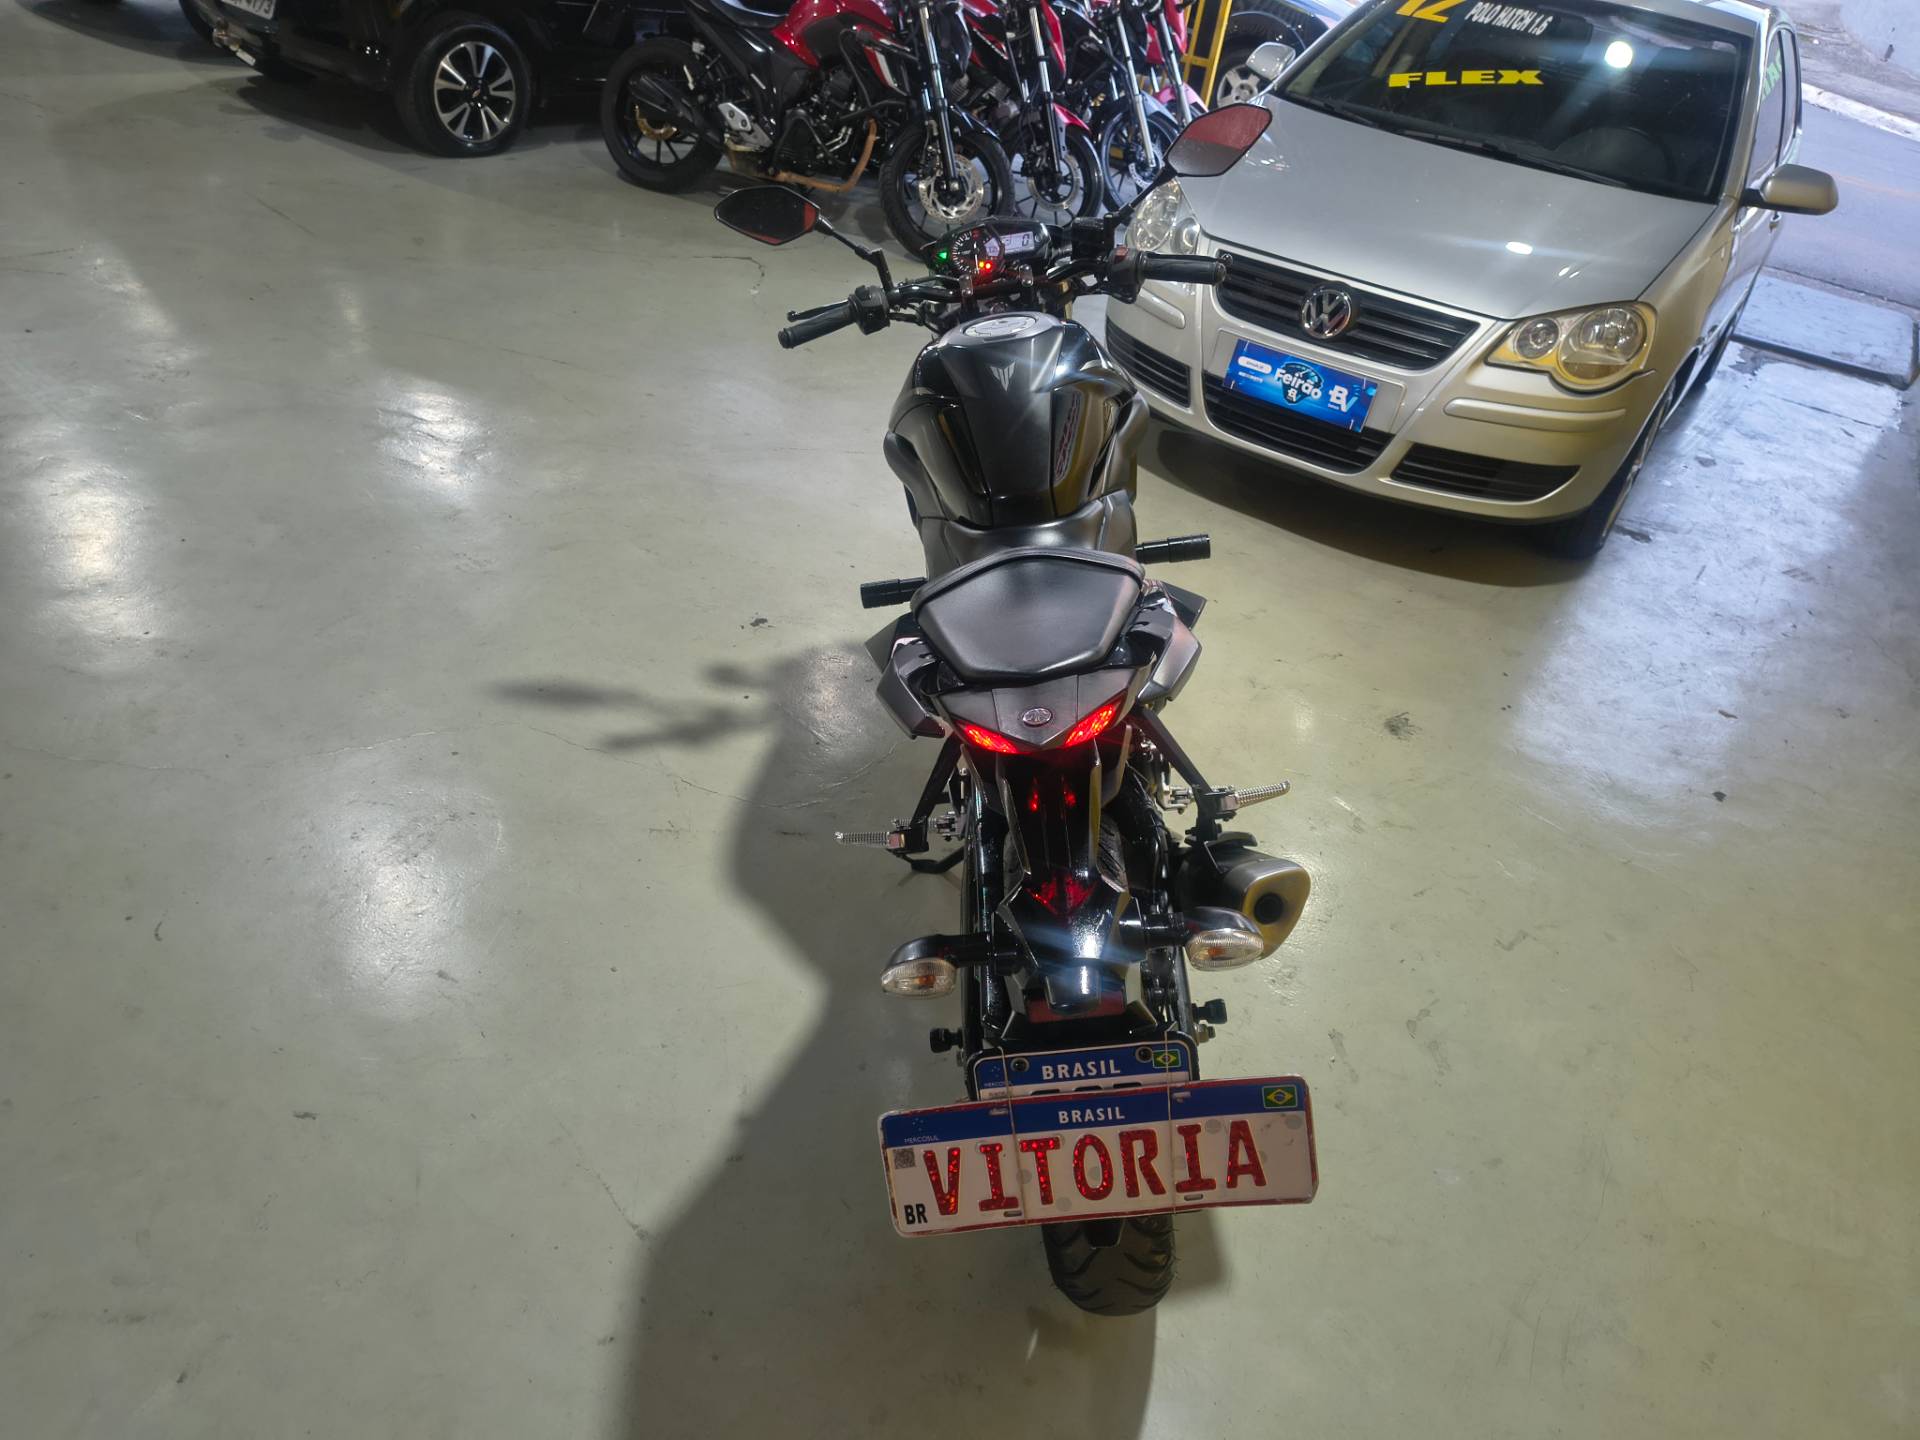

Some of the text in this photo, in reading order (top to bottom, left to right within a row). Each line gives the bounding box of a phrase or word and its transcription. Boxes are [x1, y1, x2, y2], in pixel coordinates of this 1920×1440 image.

[1464, 1, 1553, 36] POLO HATCH 1.6
[1388, 70, 1544, 88] FLEX
[1274, 367, 1322, 400] Feirão
[1041, 1059, 1121, 1081] BRASIL
[1058, 1106, 1126, 1125] BRASIL
[922, 1119, 1267, 1217] VITORIA
[904, 1203, 929, 1225] BR
